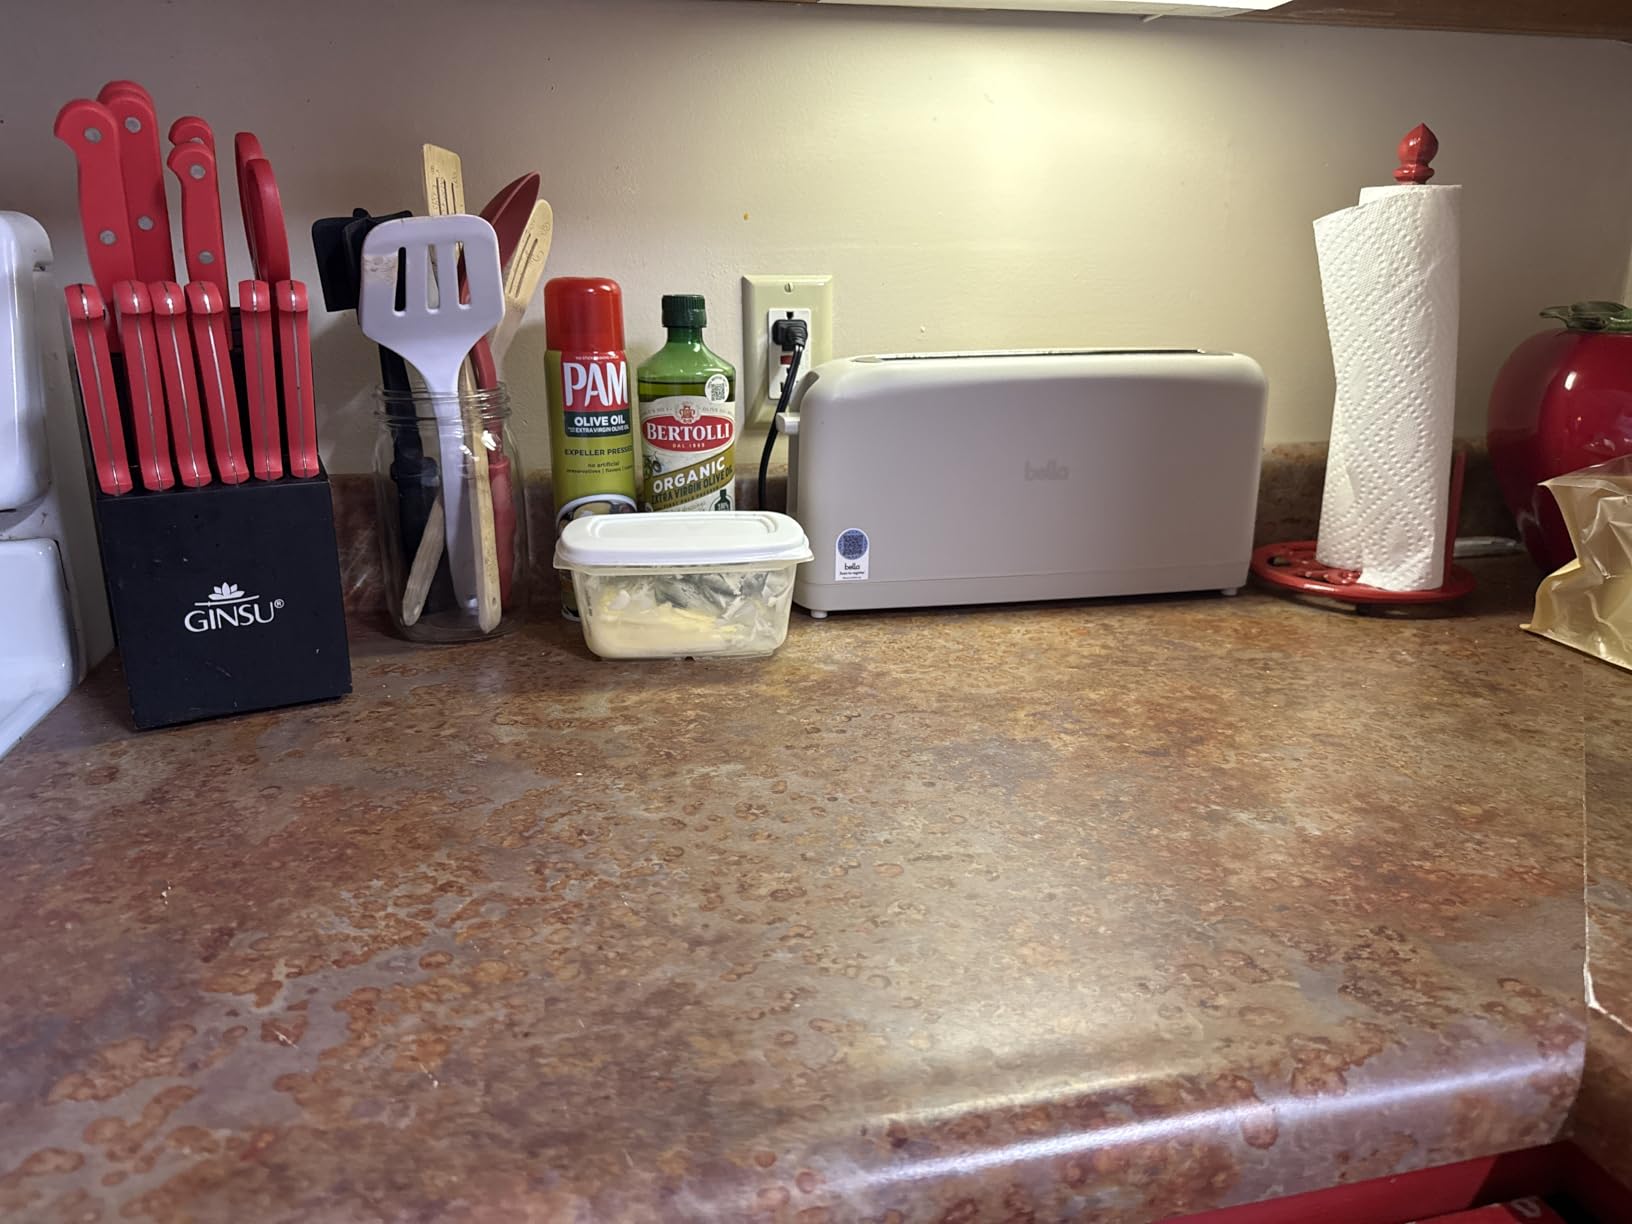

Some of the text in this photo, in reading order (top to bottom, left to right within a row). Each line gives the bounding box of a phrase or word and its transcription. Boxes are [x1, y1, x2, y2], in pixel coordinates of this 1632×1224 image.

[563, 361, 628, 407] PAM
[574, 415, 626, 427] OLIVE OIL
[646, 422, 730, 442] BERTOLLI
[652, 491, 673, 504] EXTRA
[674, 483, 702, 500] VIRGIN
[704, 471, 725, 488] OLIVE
[653, 456, 726, 493] ORGANIC
